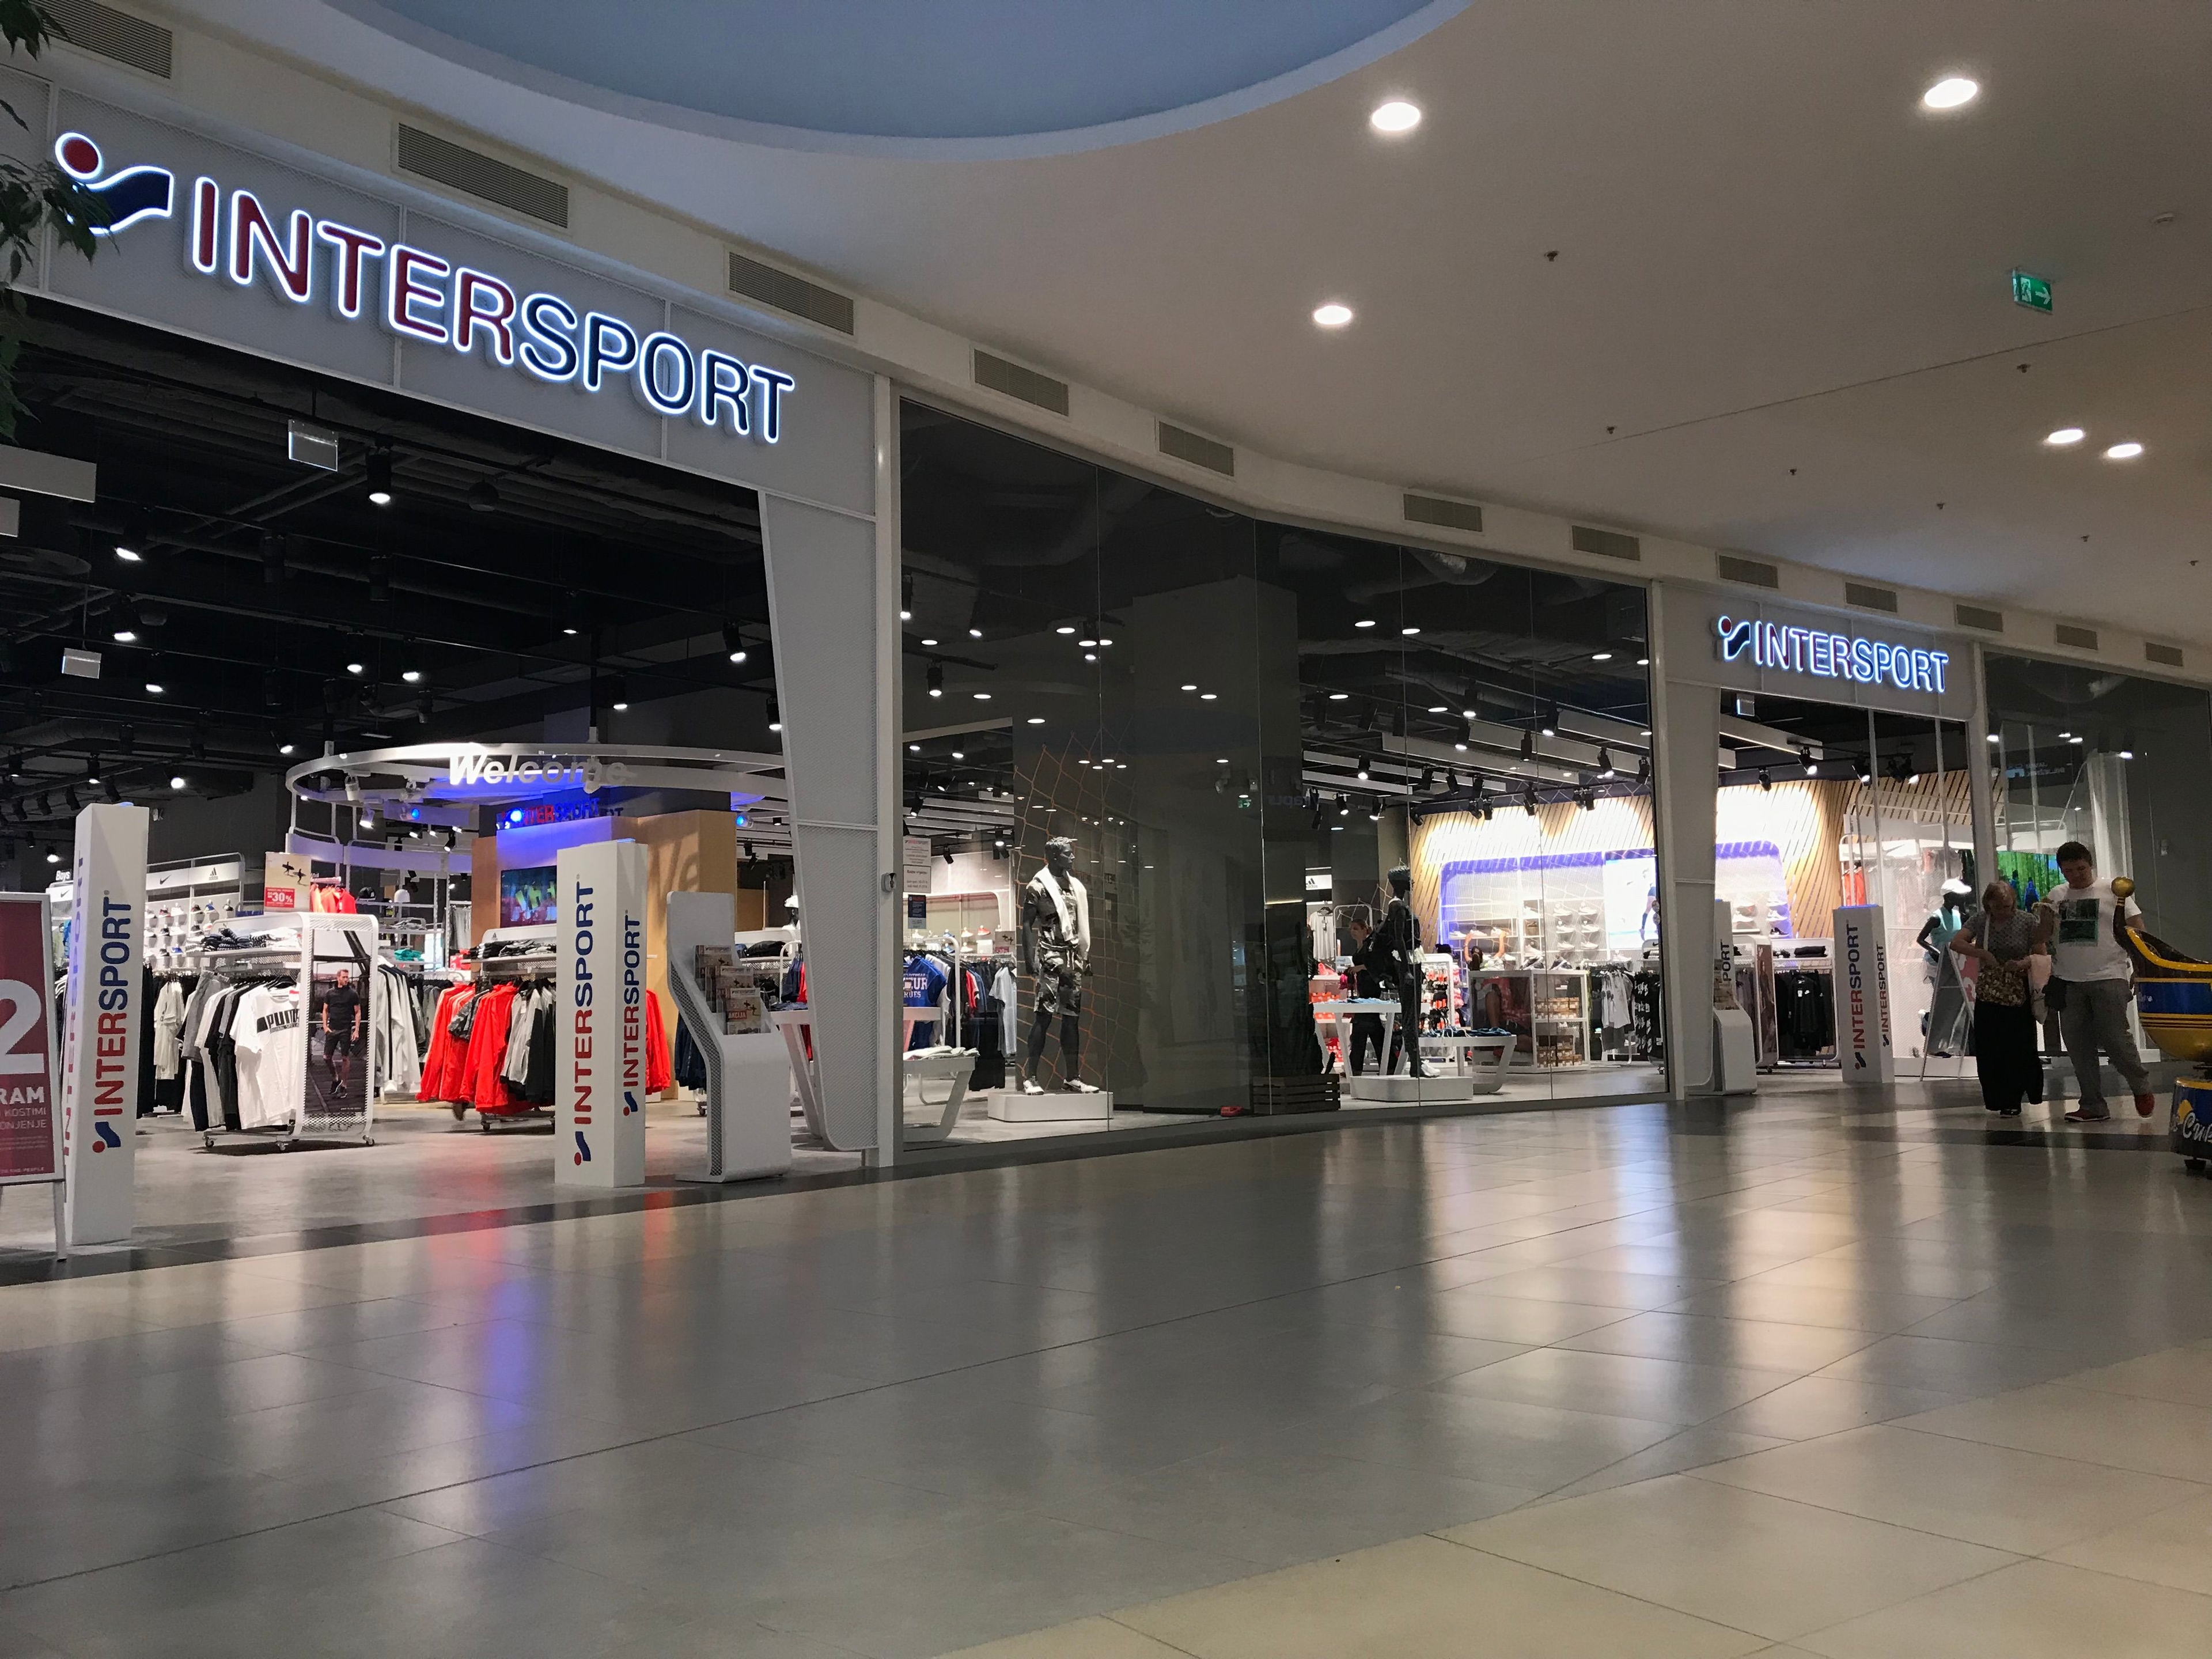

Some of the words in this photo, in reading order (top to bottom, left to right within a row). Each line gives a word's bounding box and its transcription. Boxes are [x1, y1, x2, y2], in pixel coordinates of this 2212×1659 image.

[192, 176, 794, 443] INTERSPORT
[1755, 620, 1949, 693] INTERSPORT
[56, 870, 72, 881] Boys
[93, 896, 131, 1116] INTERSPORT
[574, 881, 594, 1124] INTERSPORT
[623, 915, 640, 1088] INTERSPORT
[728, 1011, 747, 1019] AKCIJA
[1847, 924, 1865, 1049] INTERSPORT
[1877, 944, 1889, 1032] INTERSPORT
